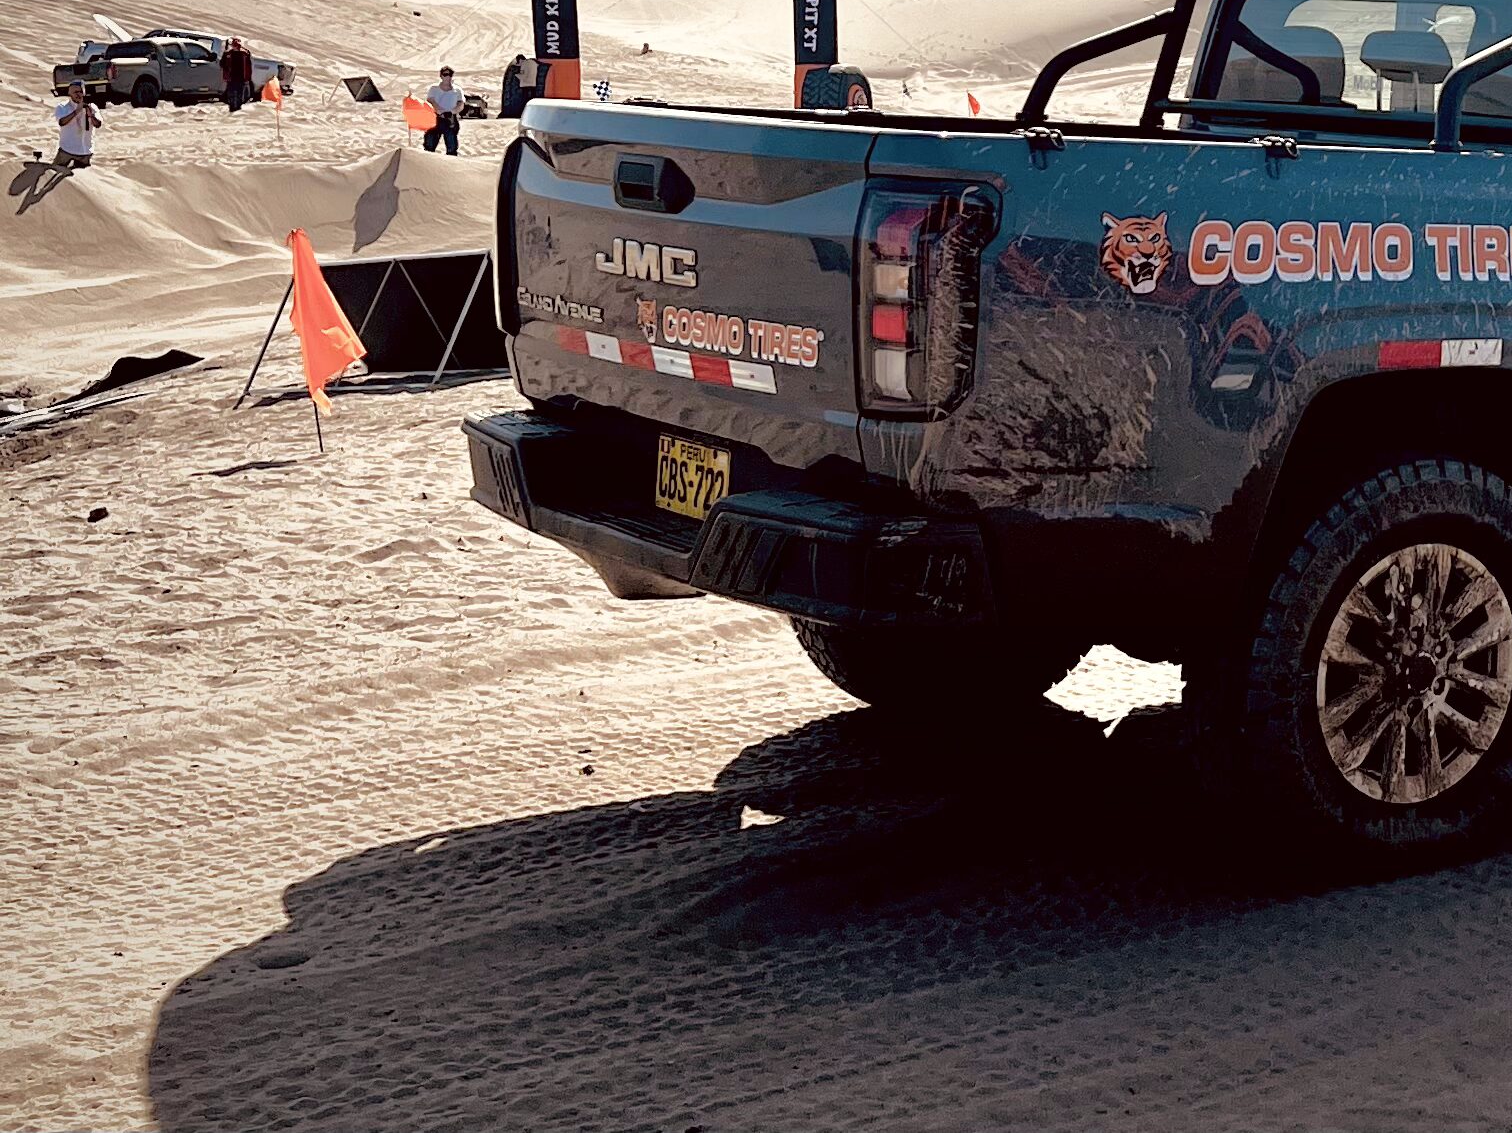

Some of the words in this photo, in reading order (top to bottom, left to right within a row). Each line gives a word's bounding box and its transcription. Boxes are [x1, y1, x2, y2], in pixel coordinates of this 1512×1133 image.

[546, 20, 561, 55] MUD
[803, 27, 818, 53] XT
[595, 236, 698, 288] JMC
[1187, 220, 1414, 286] COSMO
[662, 304, 746, 356] COSMO
[747, 318, 820, 369] TIRES
[680, 443, 706, 463] PERU
